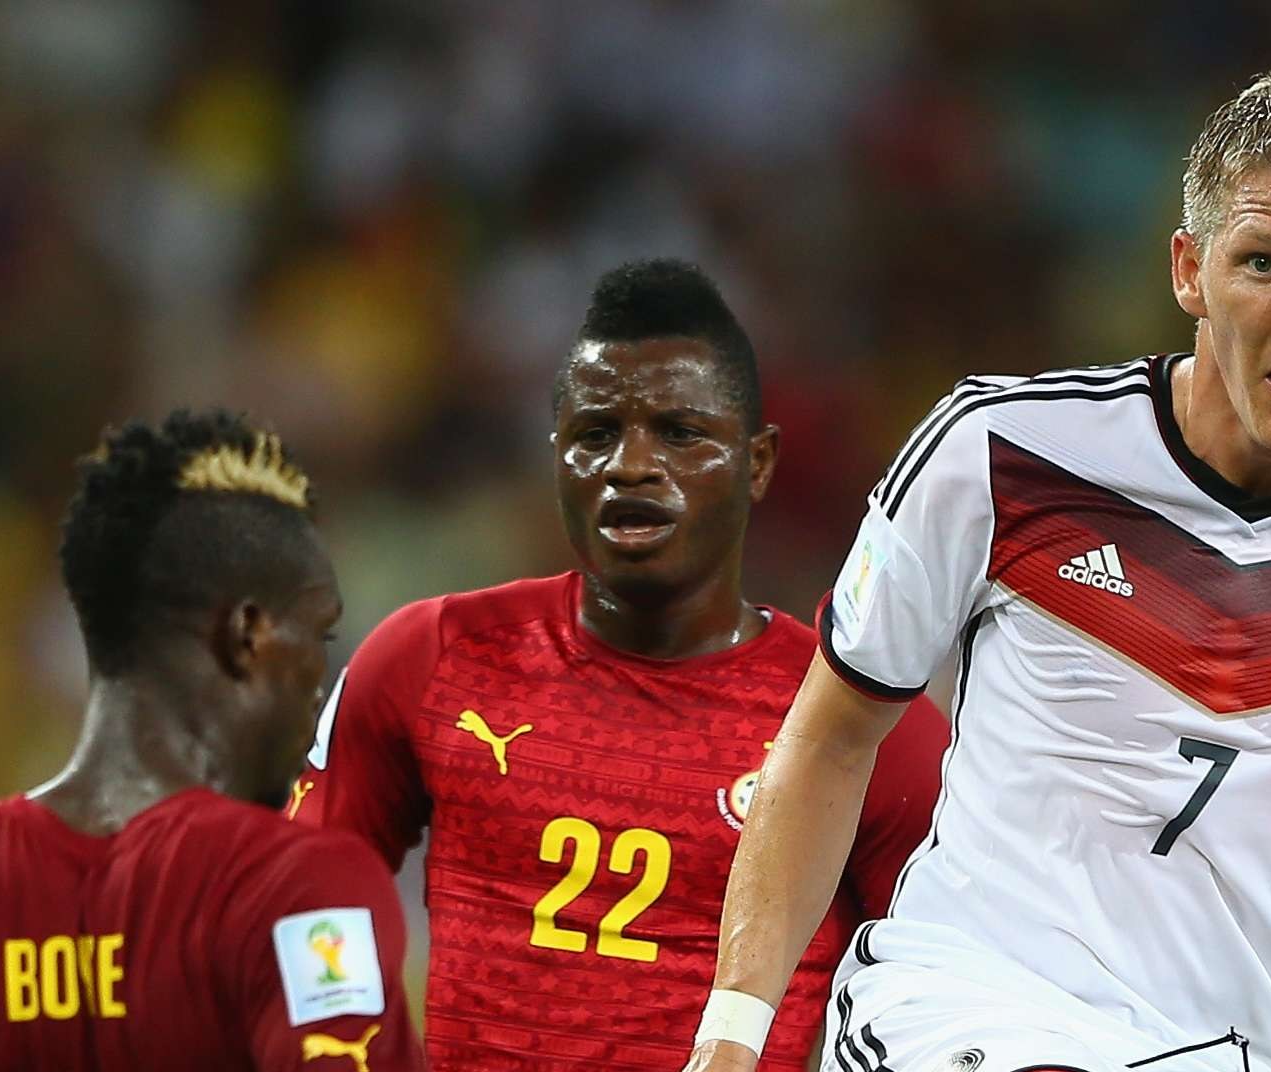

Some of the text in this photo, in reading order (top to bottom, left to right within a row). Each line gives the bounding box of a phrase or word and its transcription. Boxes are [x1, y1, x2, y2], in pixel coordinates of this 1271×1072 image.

[1058, 564, 1133, 597] adidas
[1150, 735, 1240, 857] 7
[529, 816, 672, 963] 22
